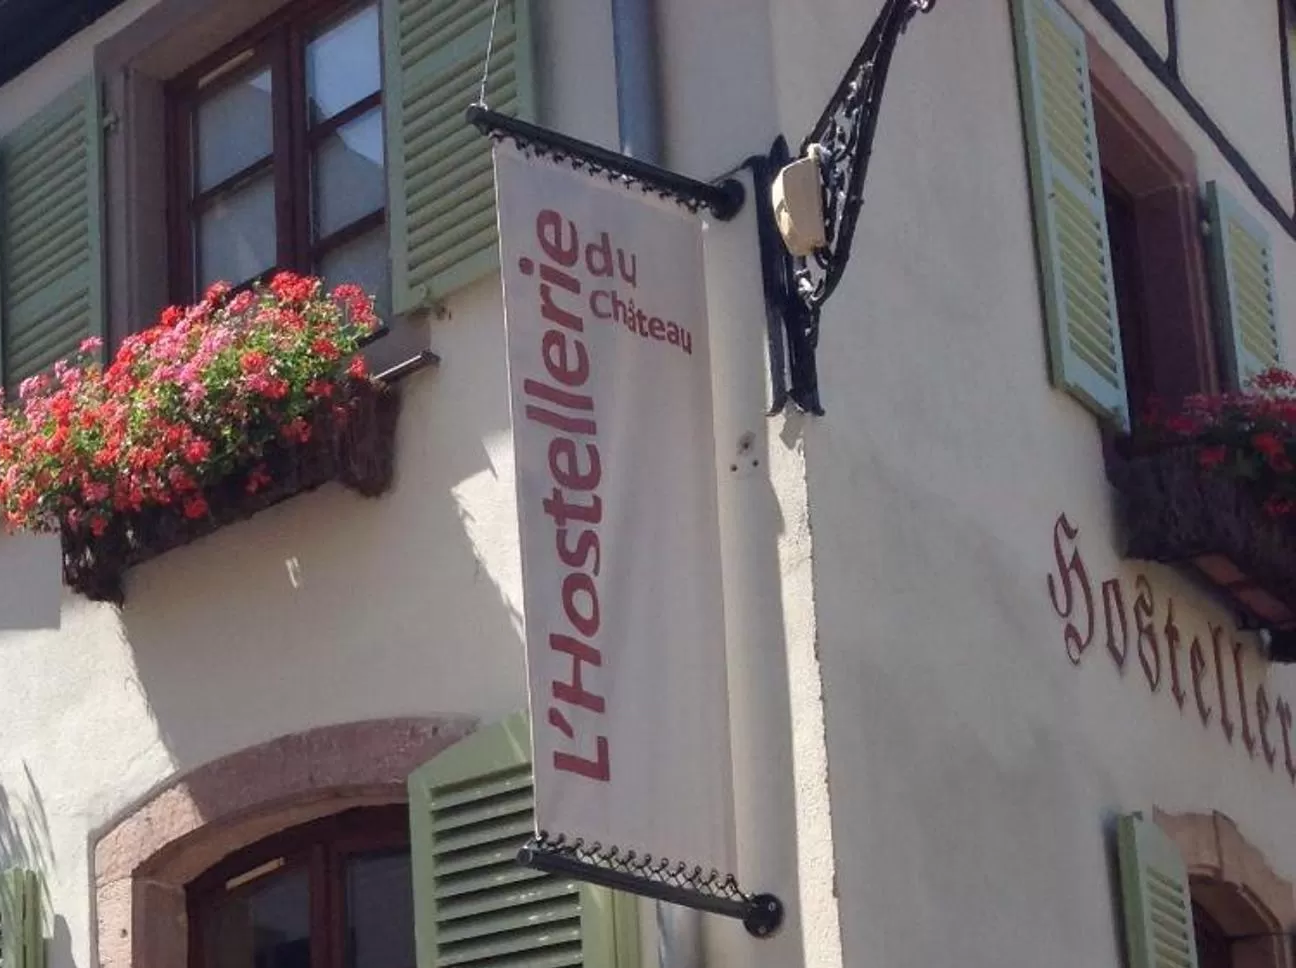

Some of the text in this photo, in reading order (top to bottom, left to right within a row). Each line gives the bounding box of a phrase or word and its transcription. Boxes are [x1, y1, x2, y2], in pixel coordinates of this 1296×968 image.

[585, 231, 637, 289] du
[589, 289, 693, 356] Château
[518, 209, 611, 782] L'Hostellerie
